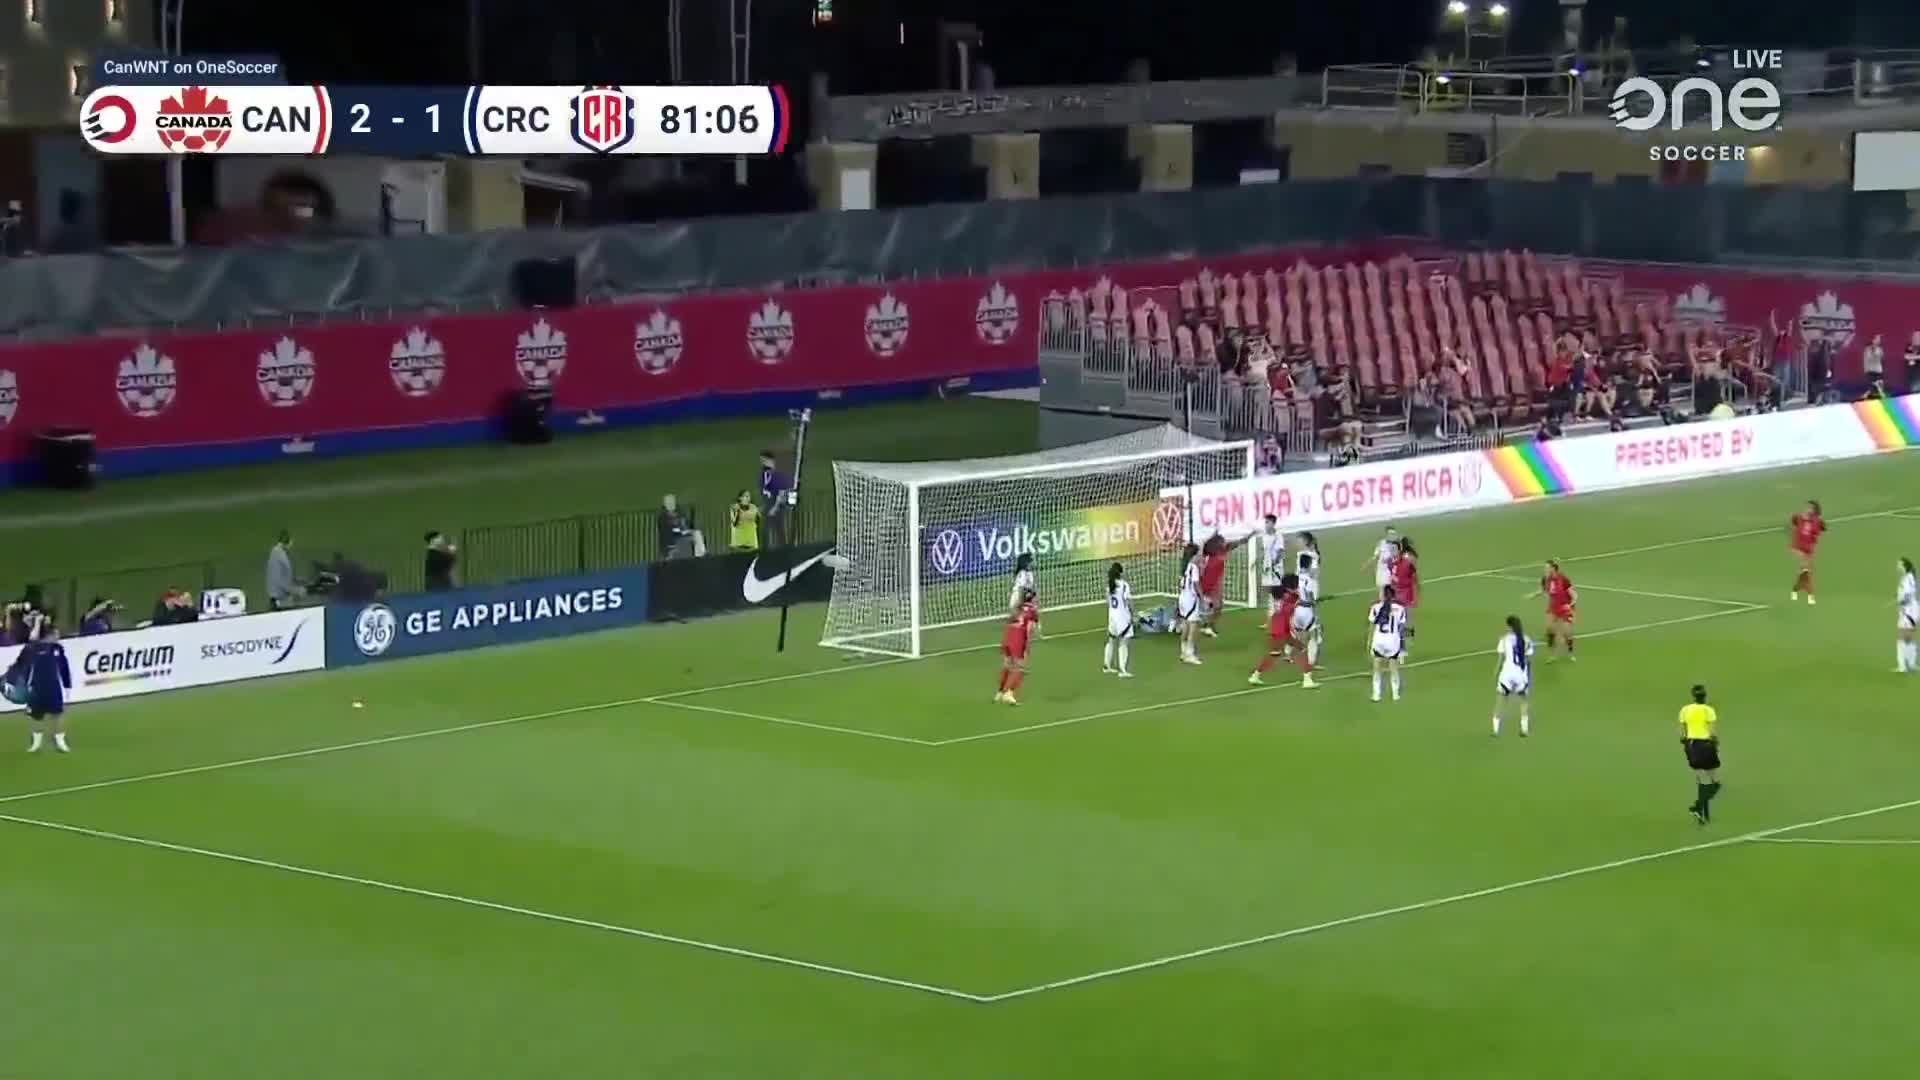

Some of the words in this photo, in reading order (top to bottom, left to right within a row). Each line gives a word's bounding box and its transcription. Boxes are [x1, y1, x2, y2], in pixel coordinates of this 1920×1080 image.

[1615, 431, 1723, 467] PRESENTED
[1731, 430, 1753, 455] BY
[1321, 475, 1393, 512] COSTA
[1402, 466, 1452, 500] RICA
[406, 609, 442, 635] GE
[452, 587, 622, 630] APPLIANCES
[84, 645, 174, 675] Centrum
[200, 636, 283, 659] SENSODYNE
